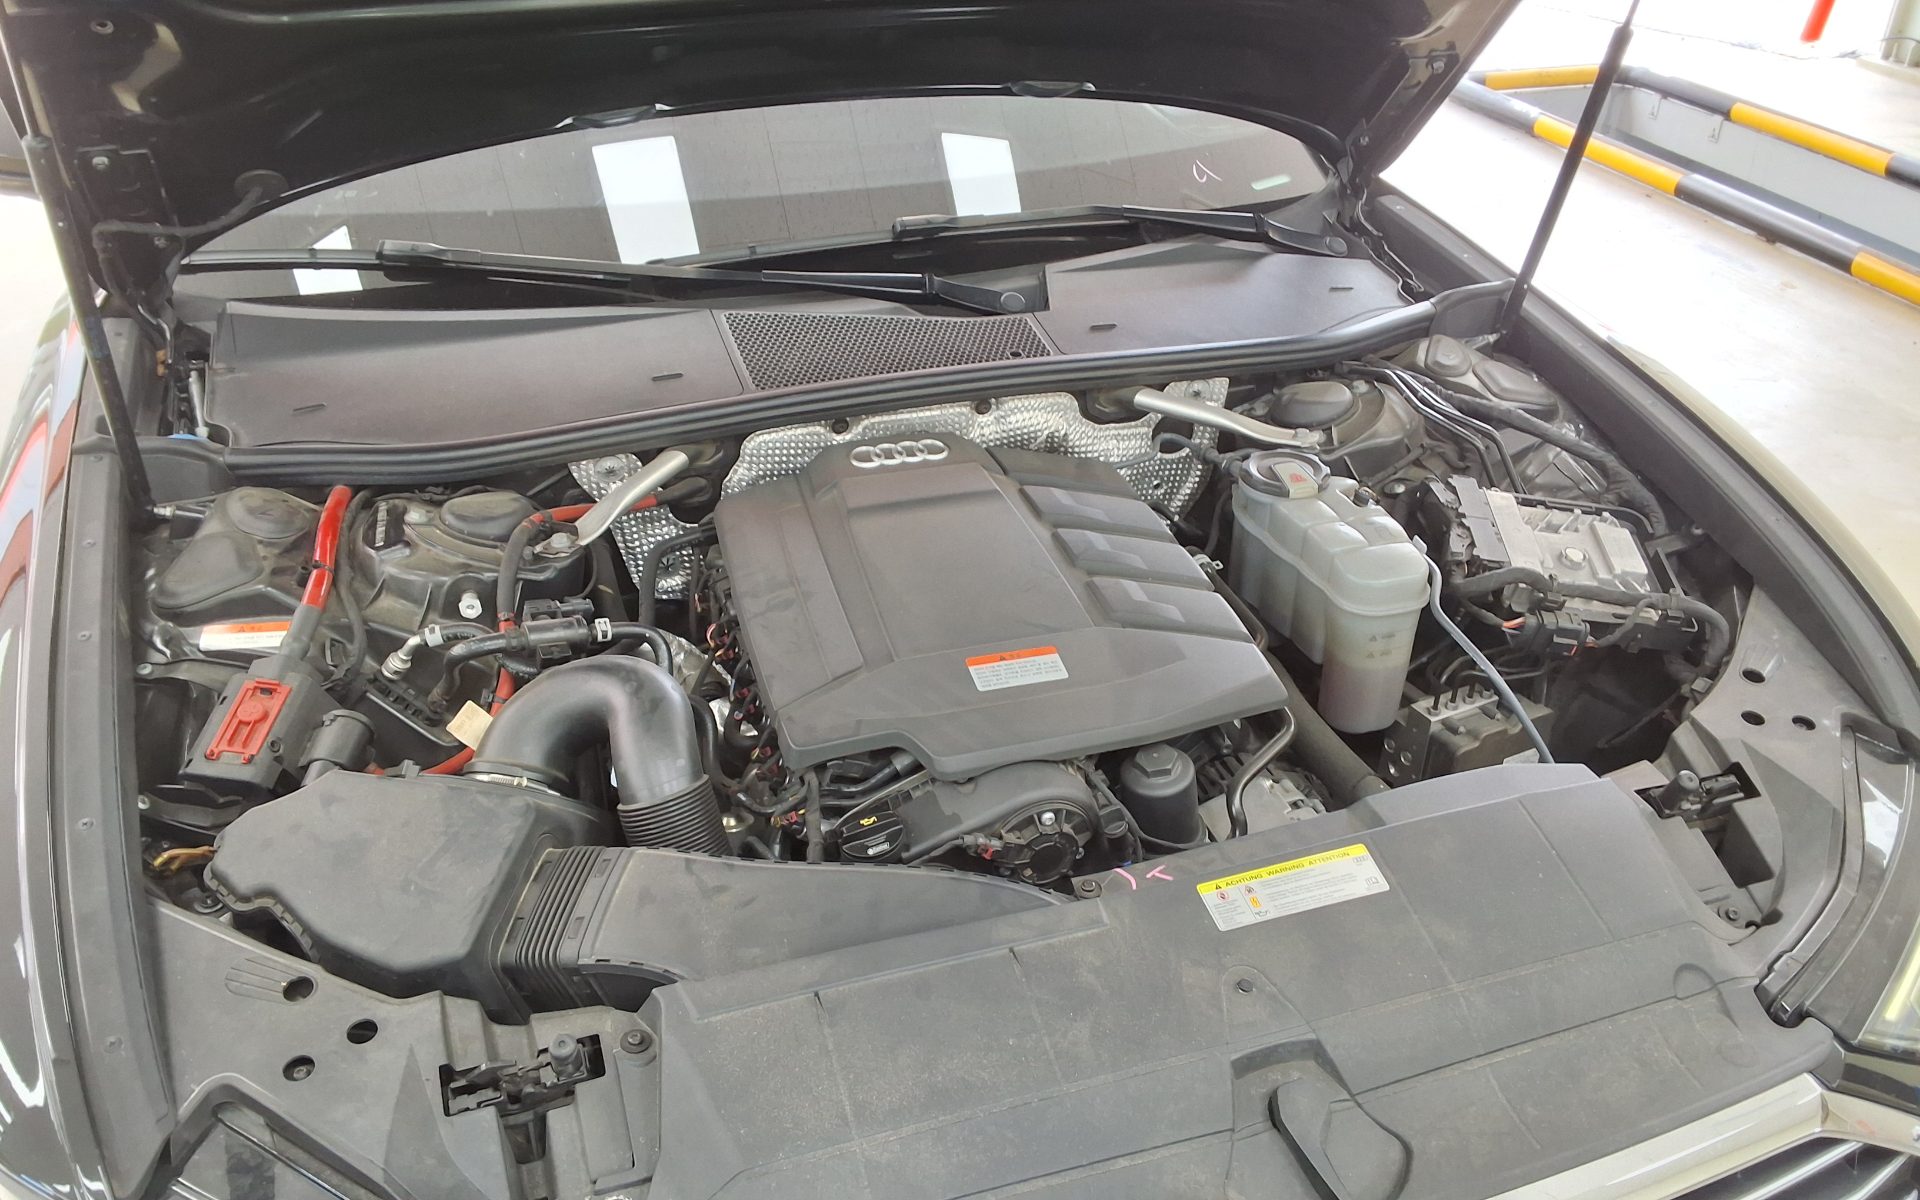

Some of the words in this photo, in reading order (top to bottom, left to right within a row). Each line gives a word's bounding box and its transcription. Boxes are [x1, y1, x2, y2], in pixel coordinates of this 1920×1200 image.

[1225, 873, 1264, 887] ACHTUNG
[1266, 863, 1305, 877] WARNING
[1308, 852, 1350, 866] ATTENTION
